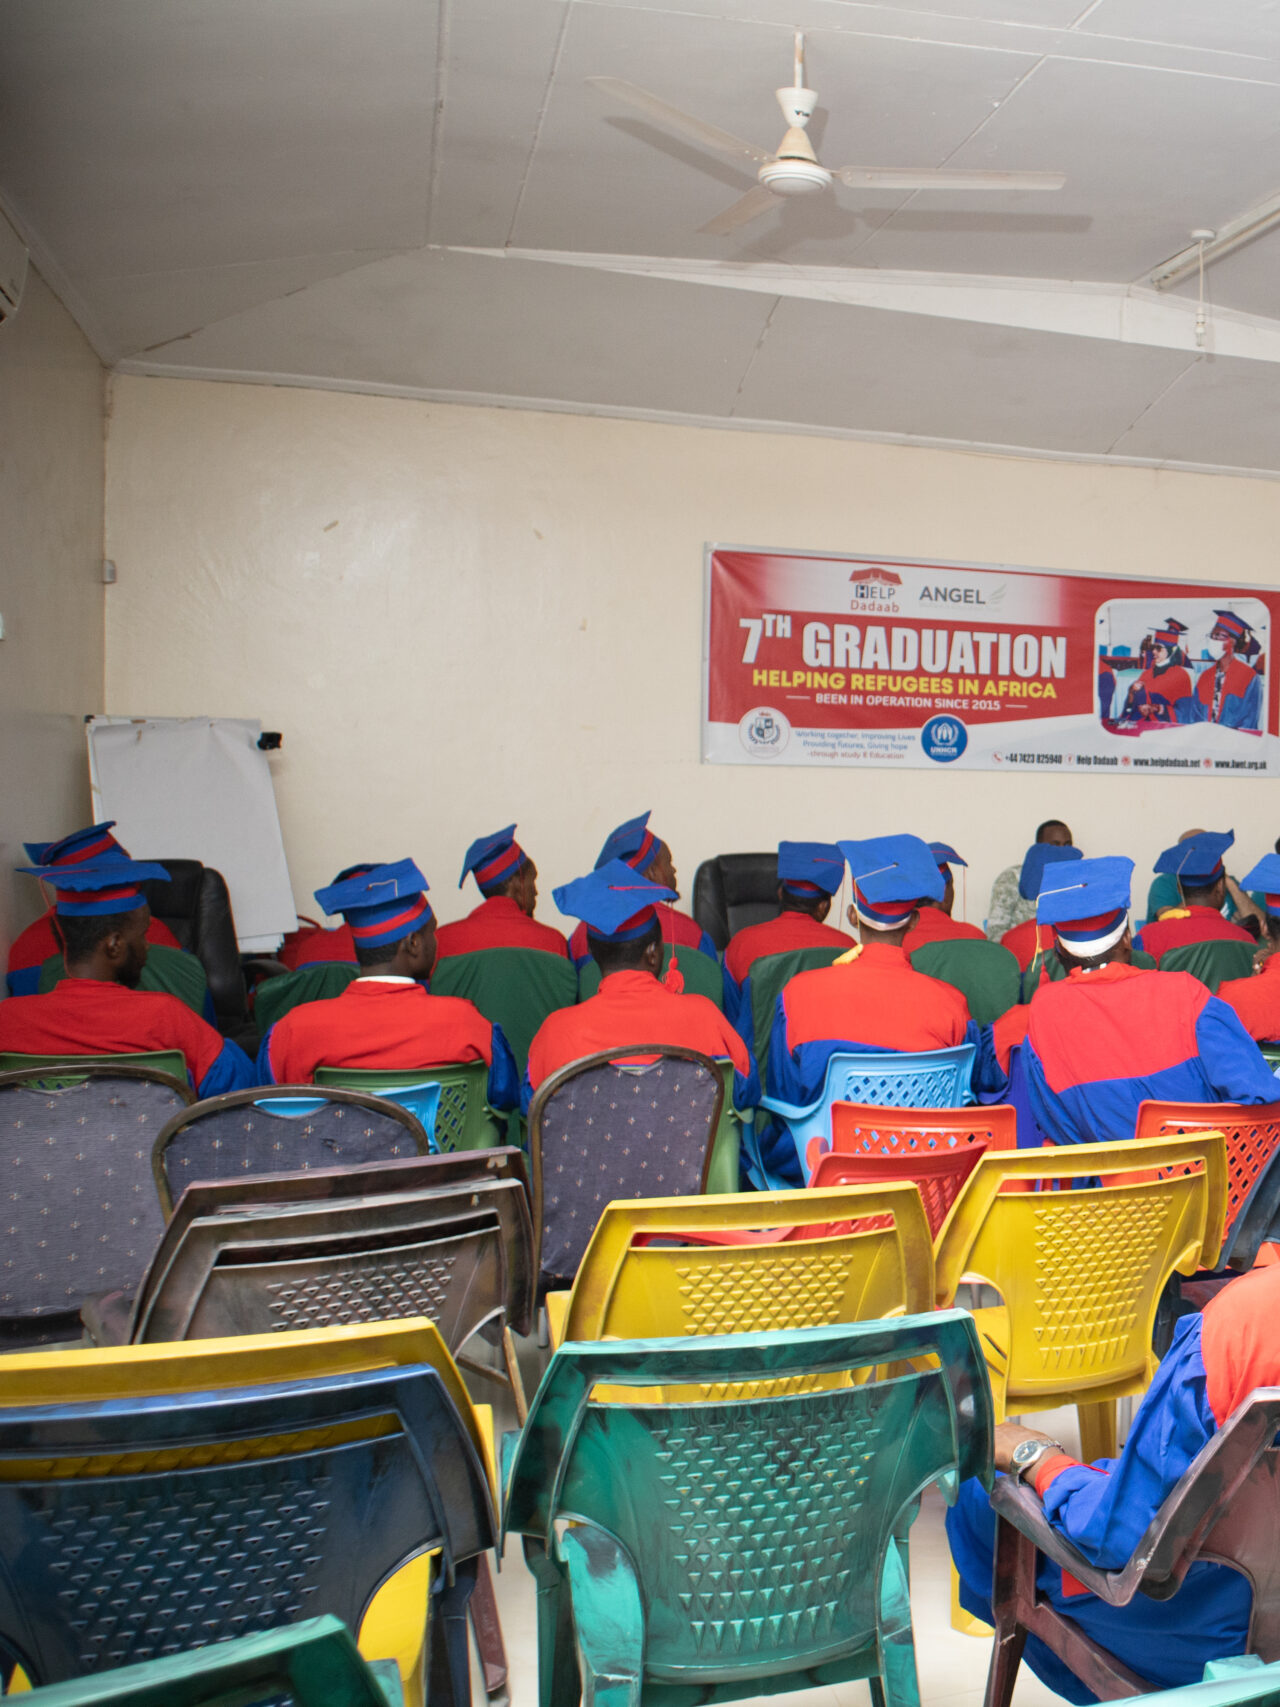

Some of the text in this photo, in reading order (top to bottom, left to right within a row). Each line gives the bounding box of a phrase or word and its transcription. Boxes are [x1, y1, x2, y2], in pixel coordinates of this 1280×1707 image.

[855, 584, 896, 600] HELP
[919, 586, 986, 604] ANGEL
[850, 600, 900, 613] Dadaab
[739, 613, 1067, 679] 7TH GRADUATION
[752, 669, 1057, 699] HELPING REFUGEES IN AFRICA
[815, 693, 1001, 711] BEEN IN OPERATION SINCE 2015
[795, 730, 825, 740] Working
[897, 733, 916, 741] Lives
[803, 739, 836, 749] Providing
[867, 742, 889, 751] Giving
[890, 743, 908, 751] hope
[1076, 755, 1118, 765] Help Dadaab
[1133, 757, 1200, 768] www.helpdadaab.net
